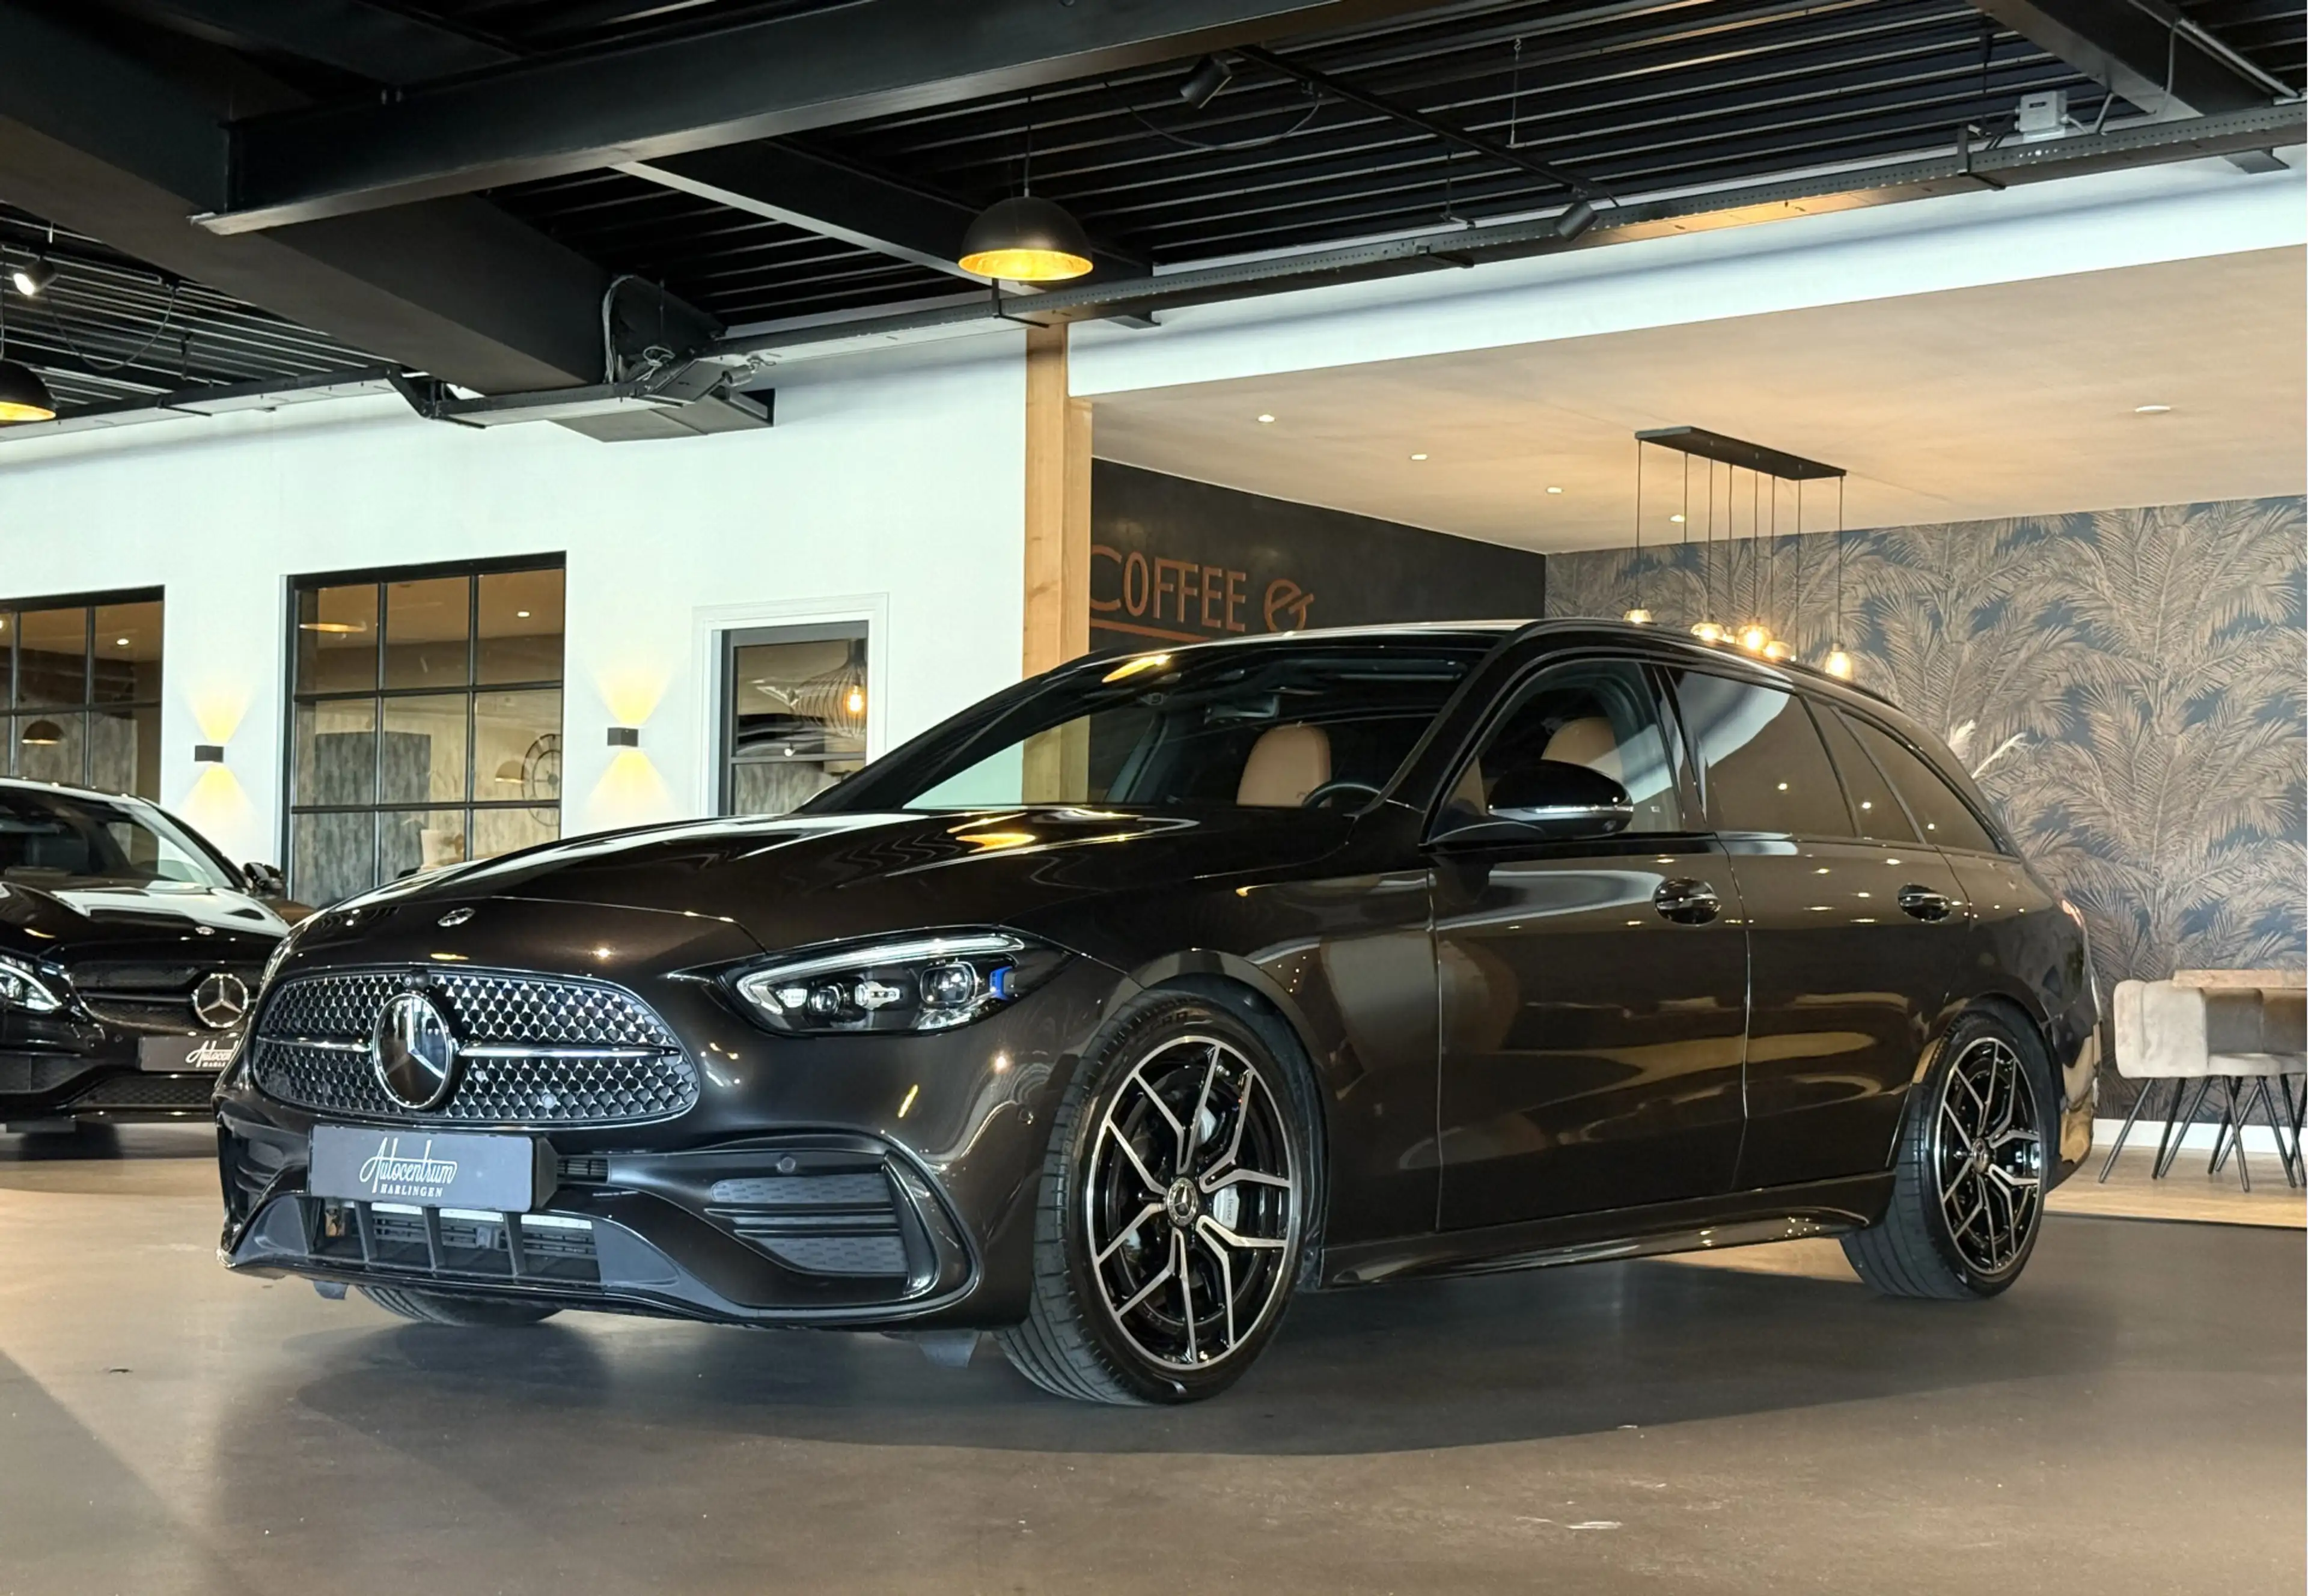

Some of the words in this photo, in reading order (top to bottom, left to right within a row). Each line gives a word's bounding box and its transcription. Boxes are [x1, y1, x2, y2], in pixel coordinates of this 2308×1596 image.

[1090, 544, 1246, 632] COFFEE
[359, 1136, 457, 1193] Autocentrum
[380, 1183, 443, 1198] HARLINGEN
